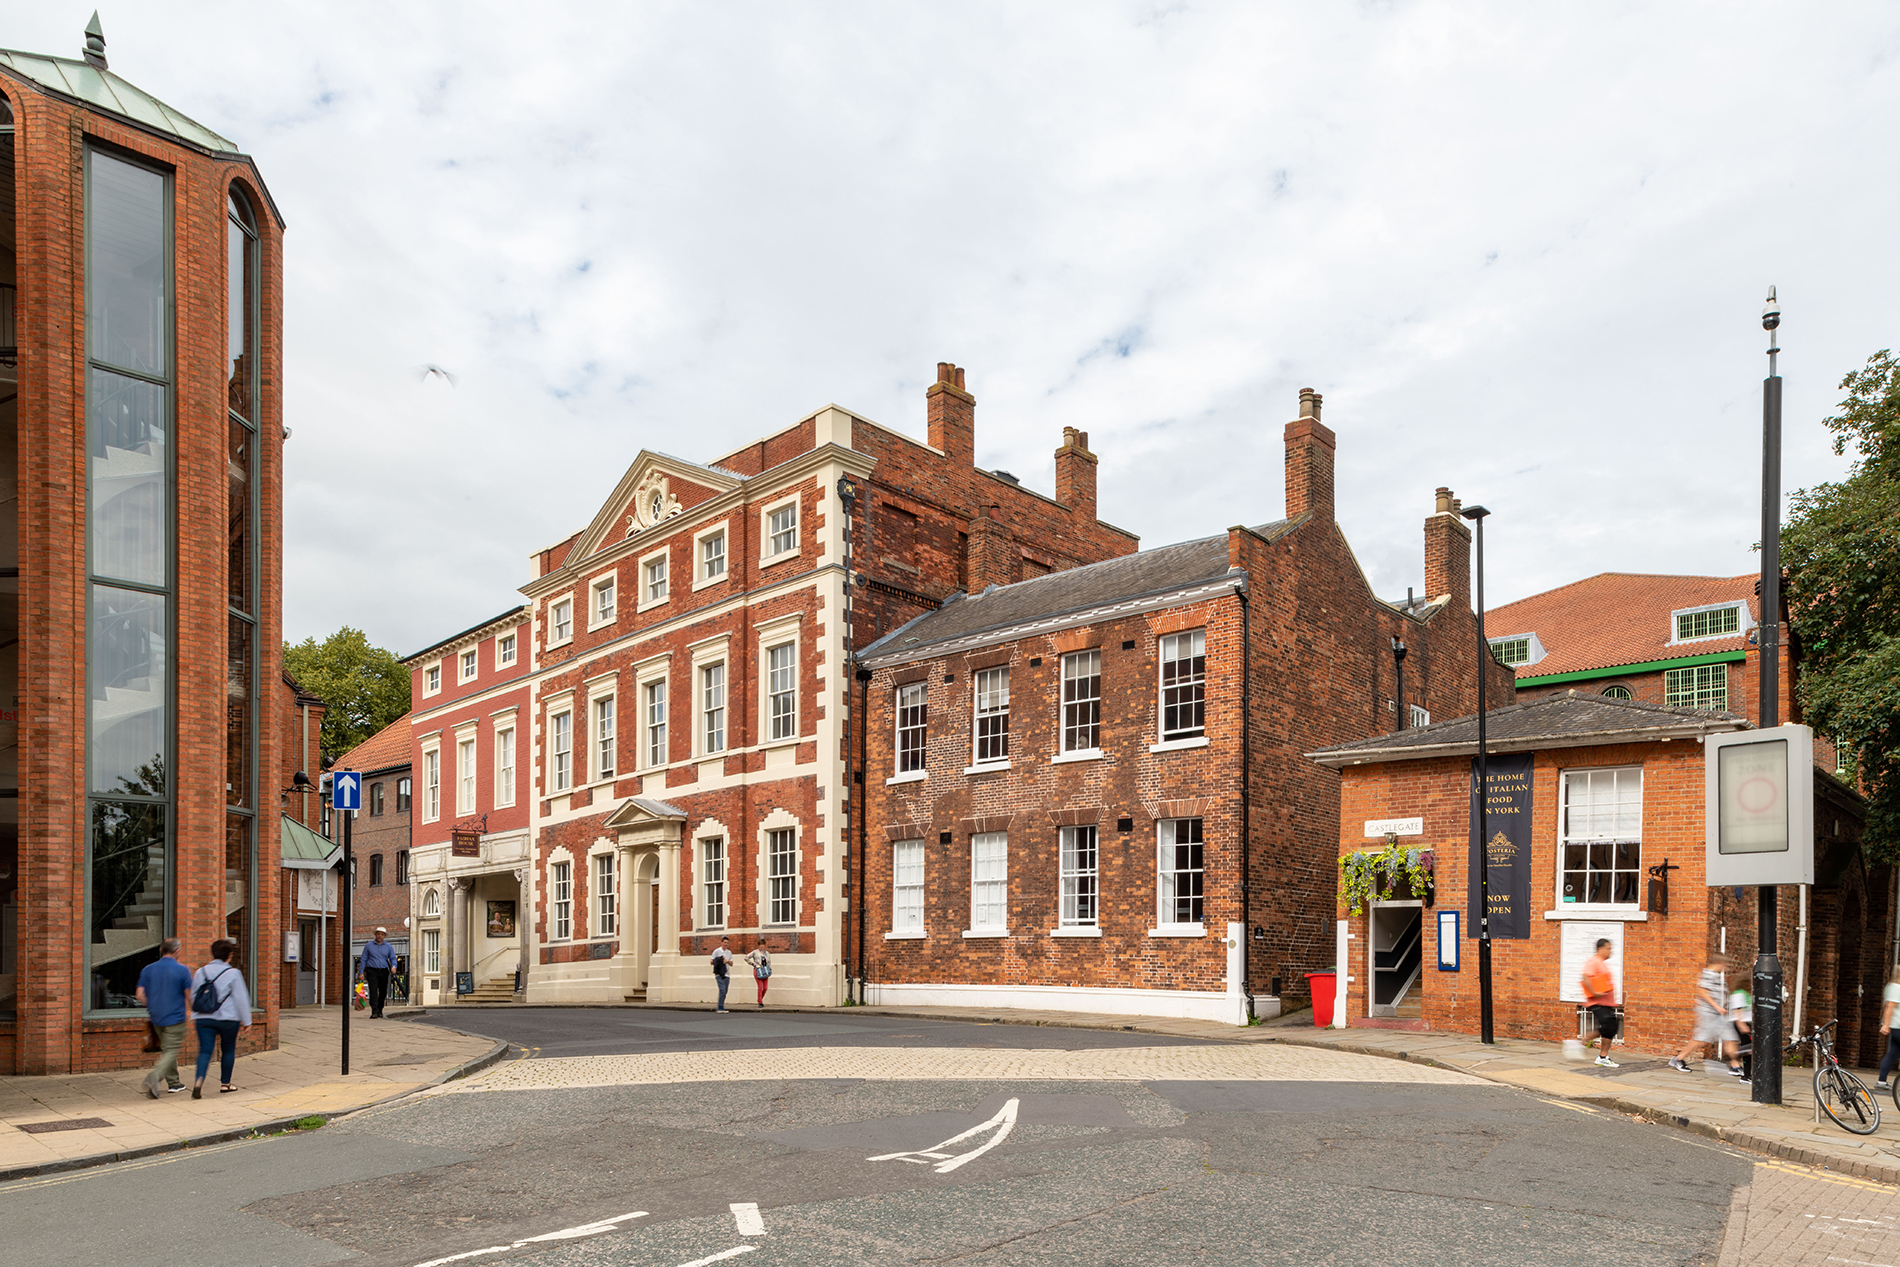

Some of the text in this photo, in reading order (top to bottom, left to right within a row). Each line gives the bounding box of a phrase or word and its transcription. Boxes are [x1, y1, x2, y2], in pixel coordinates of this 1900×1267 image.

[1498, 773, 1524, 782] HOME
[1490, 784, 1528, 792] ITALIAN
[1487, 796, 1512, 804] FOOD
[1368, 823, 1419, 832] CASTLEGATE
[1487, 894, 1511, 902] NOW
